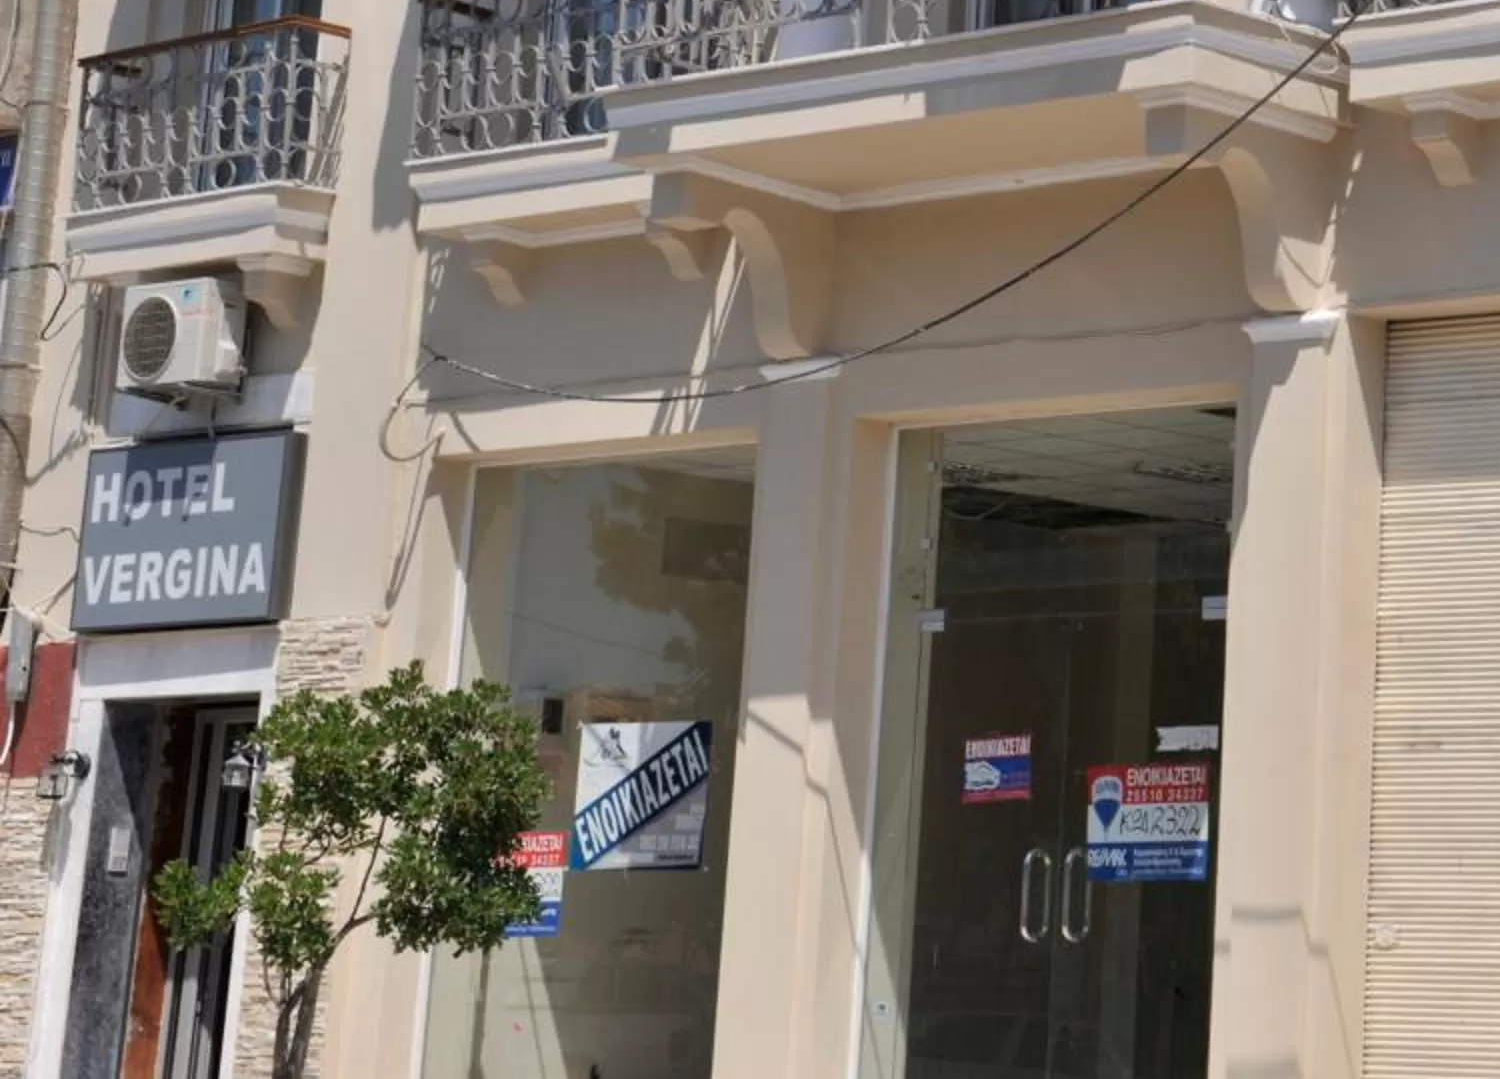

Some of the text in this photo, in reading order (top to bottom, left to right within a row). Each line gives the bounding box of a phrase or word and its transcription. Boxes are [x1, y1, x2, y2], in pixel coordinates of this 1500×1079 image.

[91, 462, 235, 524] HOTEL
[84, 542, 265, 606] VERGINA
[576, 728, 709, 862] ΕΝΟΙΚΙΑΖΕΤΑΙ
[1127, 766, 1206, 786] ΕΝΟΙΚΙΑΖΕΤΑΙ
